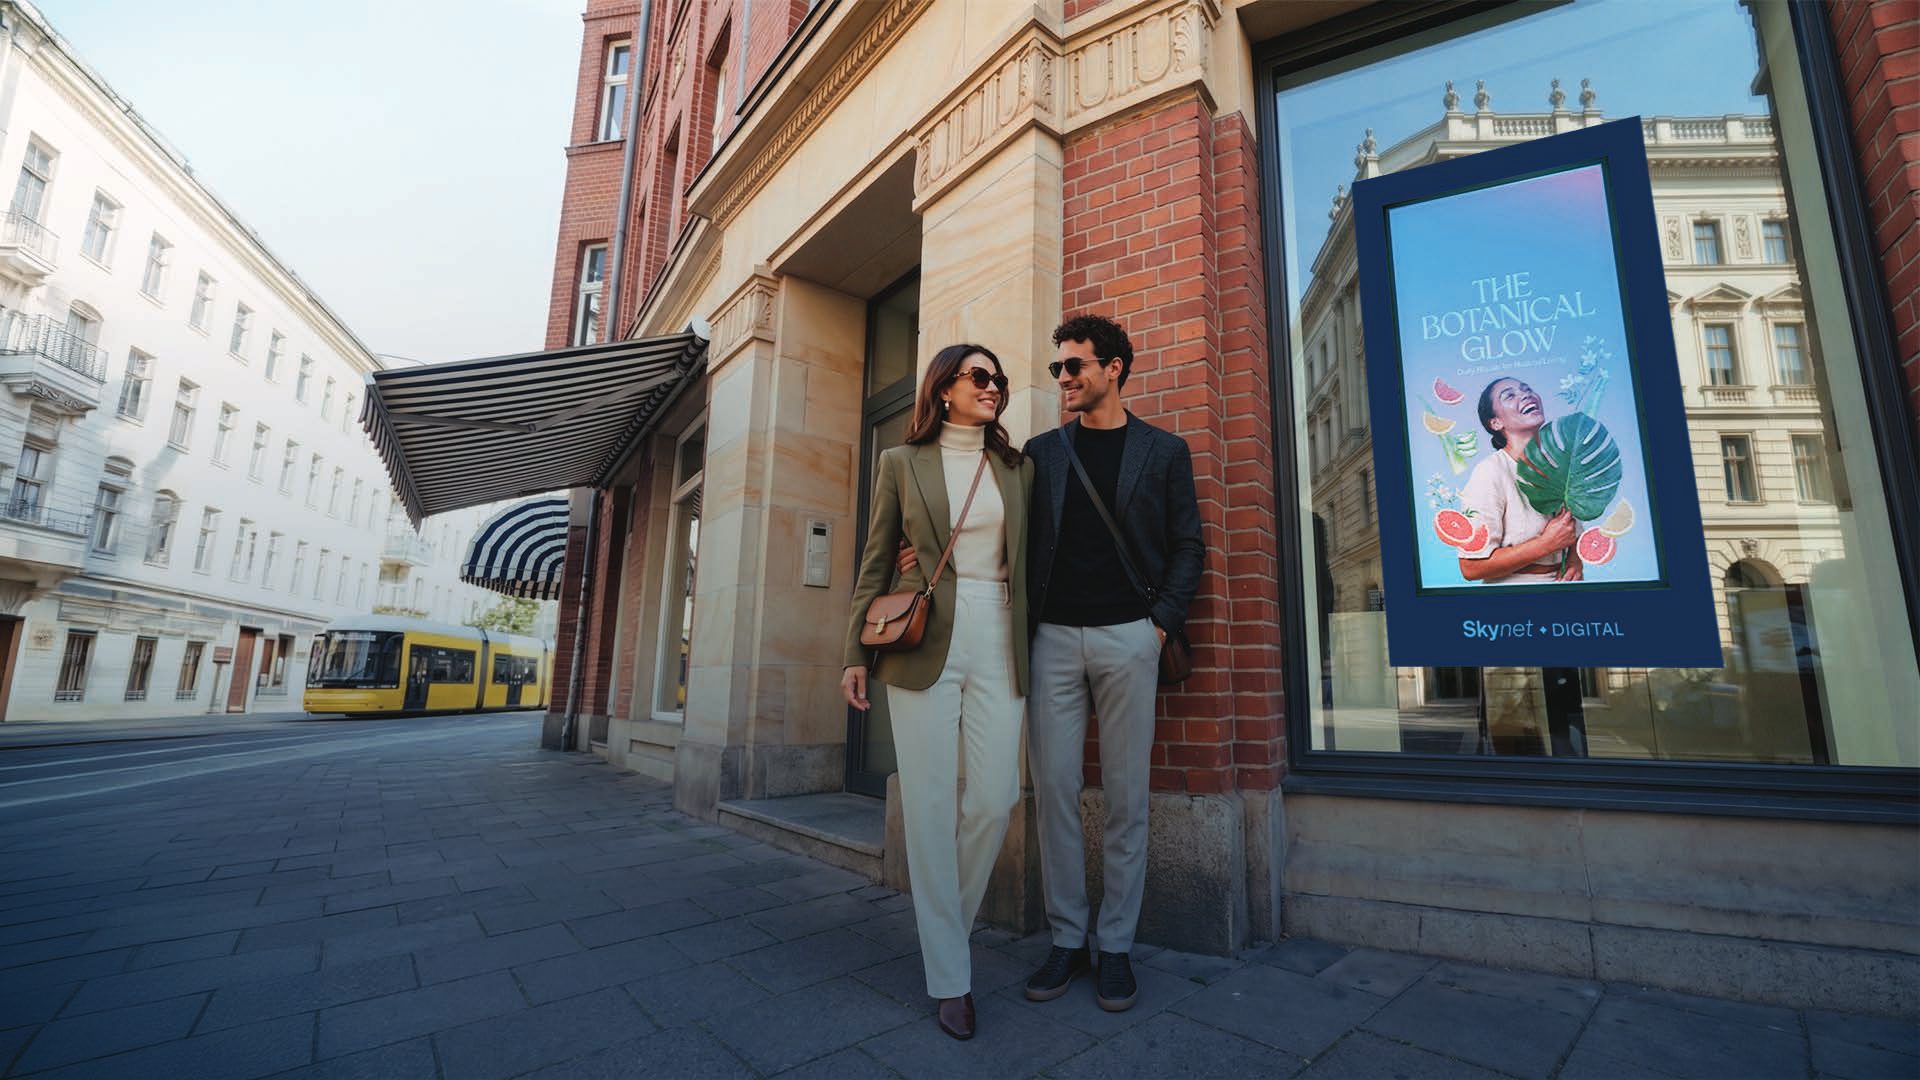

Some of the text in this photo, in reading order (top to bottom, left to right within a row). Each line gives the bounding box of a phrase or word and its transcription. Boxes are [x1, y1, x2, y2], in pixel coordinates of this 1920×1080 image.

[1472, 272, 1532, 303] THE
[1422, 291, 1596, 340] BOTANICAL
[1461, 325, 1557, 362] GLOW
[1463, 620, 1625, 641] Skynet DIGITAL
